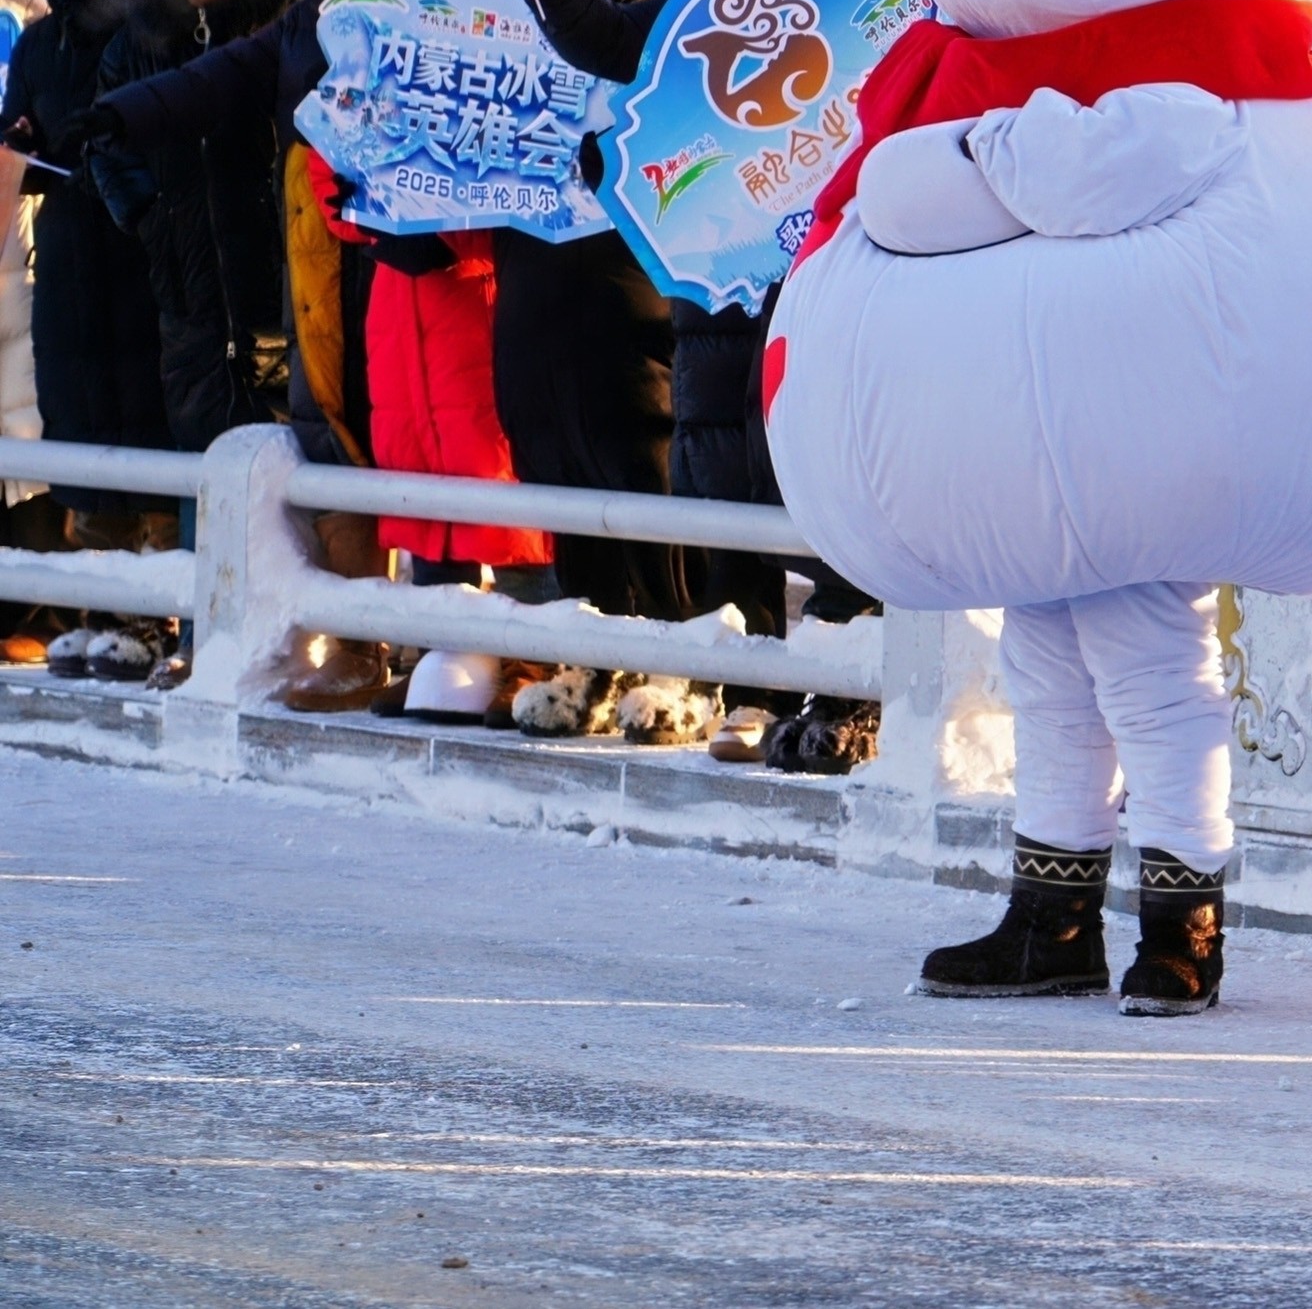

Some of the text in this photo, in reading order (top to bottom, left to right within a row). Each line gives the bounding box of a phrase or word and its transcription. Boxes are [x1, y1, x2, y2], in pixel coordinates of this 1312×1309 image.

[371, 34, 594, 121] 内蒙古冰雪
[396, 83, 584, 184] 英雄会
